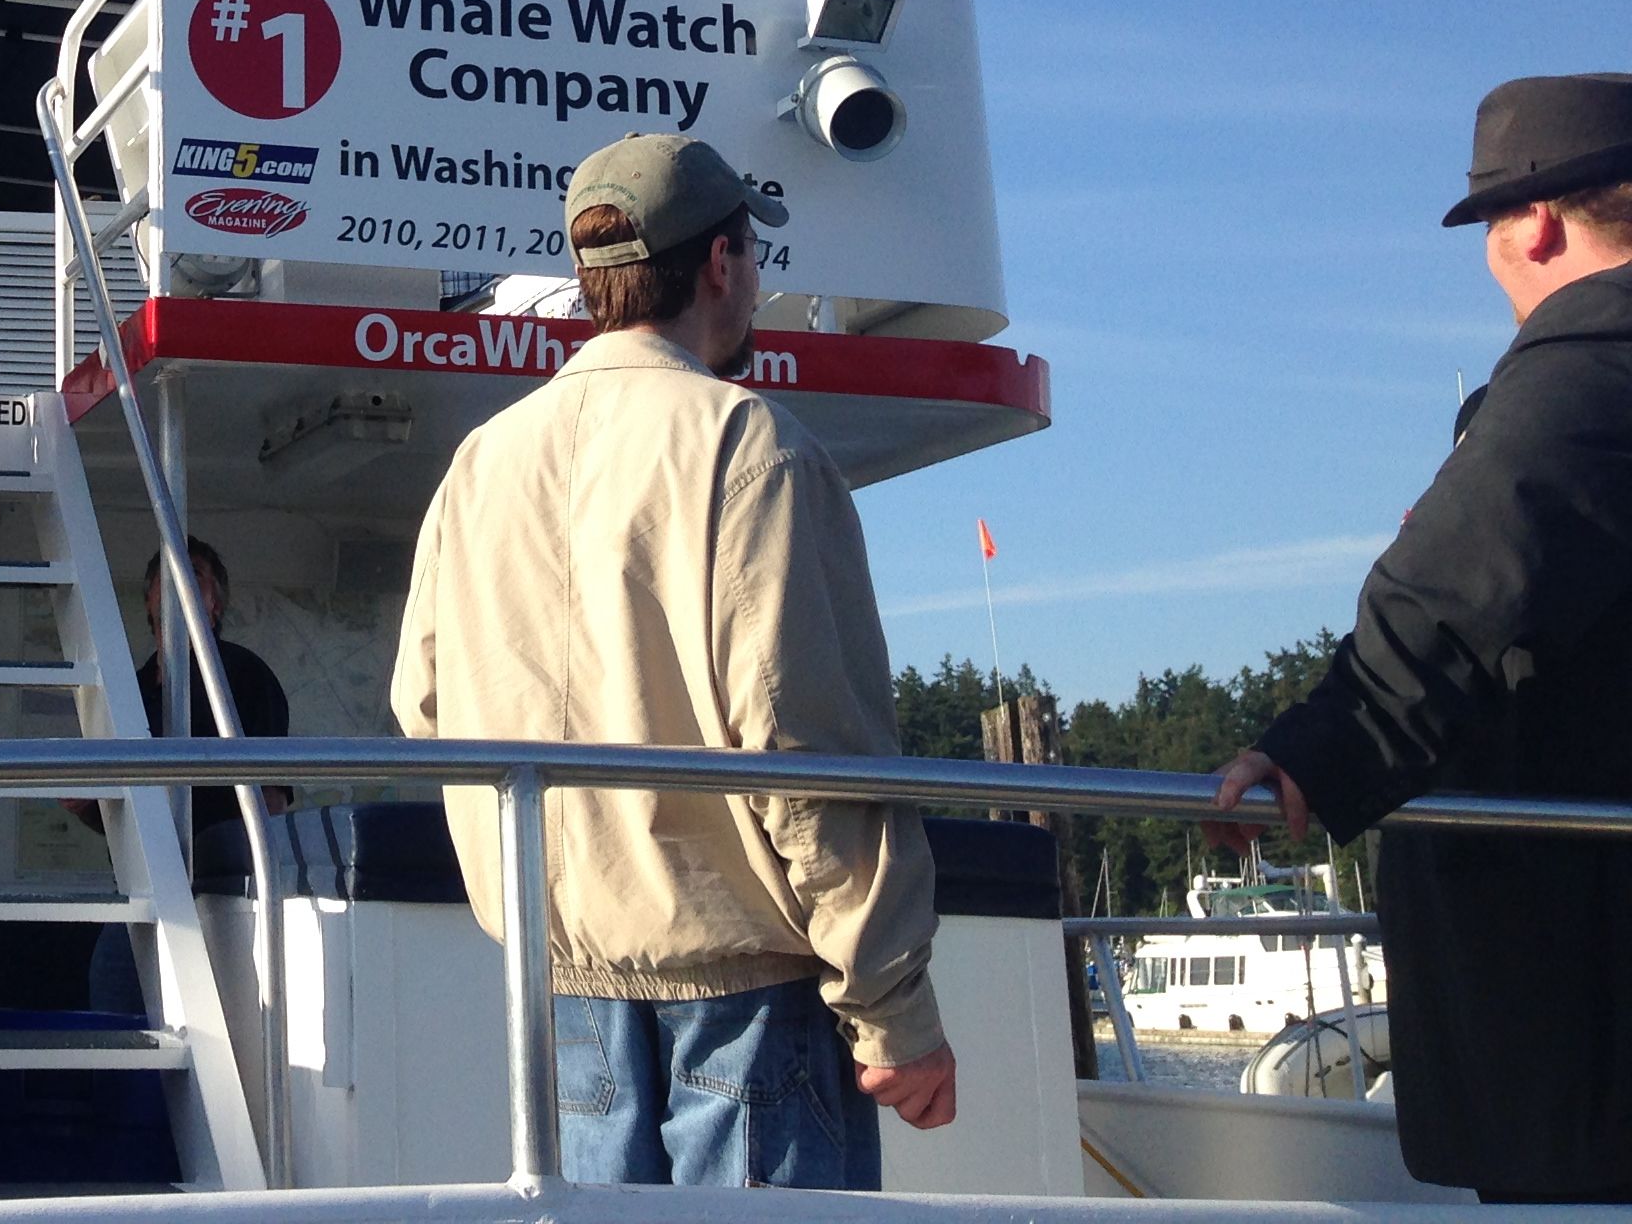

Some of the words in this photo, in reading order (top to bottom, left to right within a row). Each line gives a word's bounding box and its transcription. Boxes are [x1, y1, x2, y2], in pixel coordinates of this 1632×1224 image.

[408, 47, 710, 132] Company
[339, 139, 379, 178] in
[188, 191, 312, 239] Evening
[207, 215, 267, 229] MAGAZINE
[336, 215, 423, 251] 2010,
[431, 222, 517, 258] 2011,
